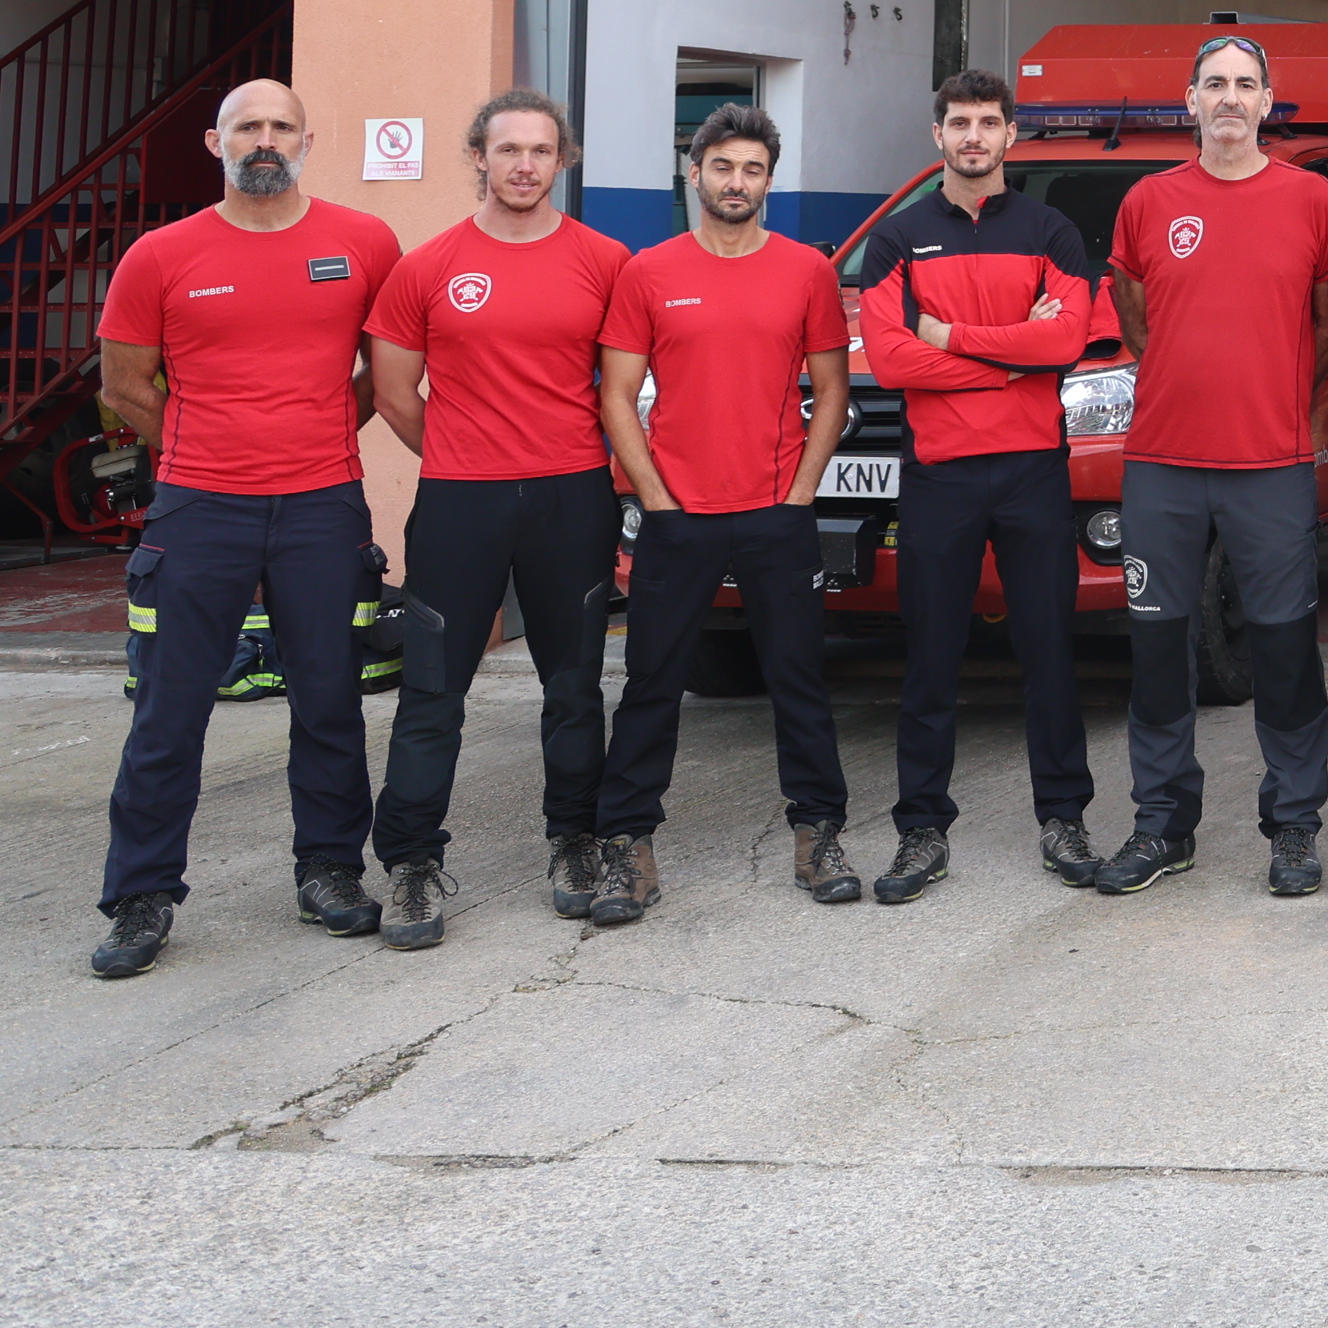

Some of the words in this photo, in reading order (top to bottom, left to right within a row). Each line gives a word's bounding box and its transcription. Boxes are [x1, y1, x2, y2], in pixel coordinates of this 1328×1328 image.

[189, 286, 235, 298] BOMBERS
[665, 297, 702, 308] BOMBERS
[836, 463, 892, 493] KNV
